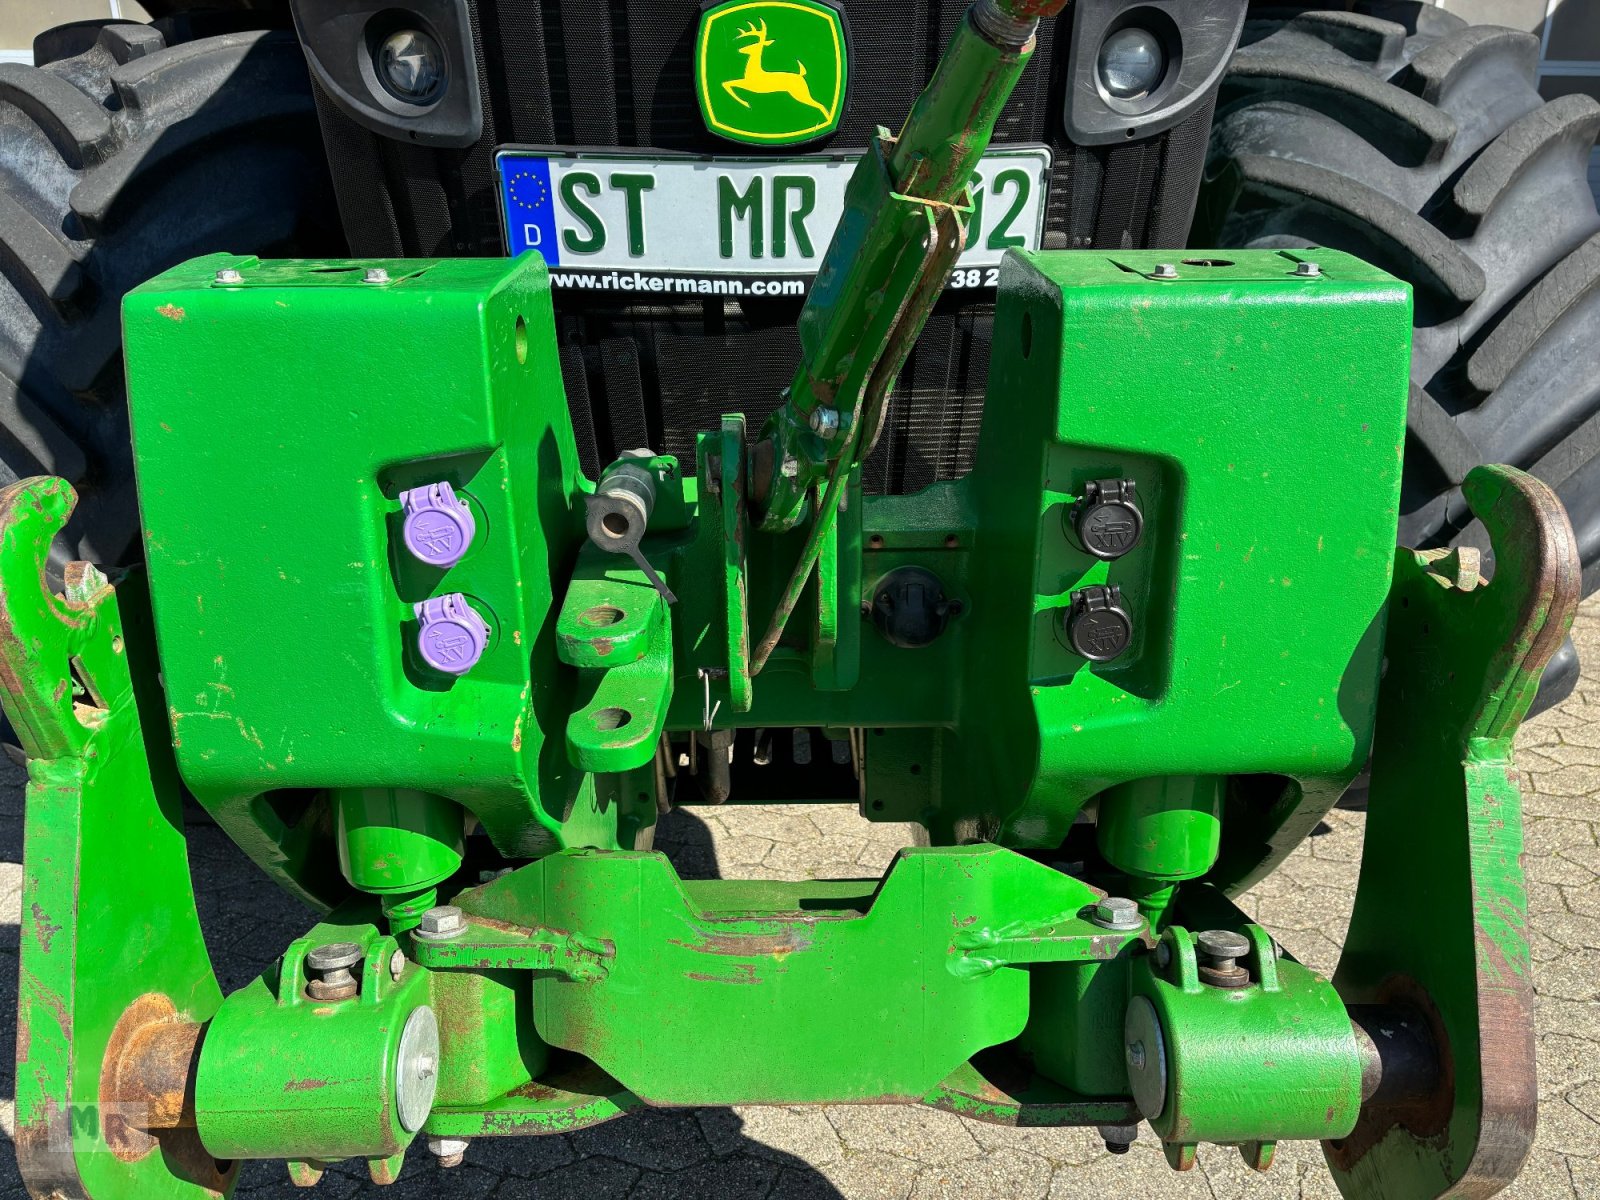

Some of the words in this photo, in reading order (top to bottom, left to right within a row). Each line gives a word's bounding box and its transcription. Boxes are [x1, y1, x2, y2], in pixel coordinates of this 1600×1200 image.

[560, 171, 655, 256] ST
[718, 175, 816, 258] MR
[524, 224, 541, 245] D
[1094, 531, 1131, 548] XIV
